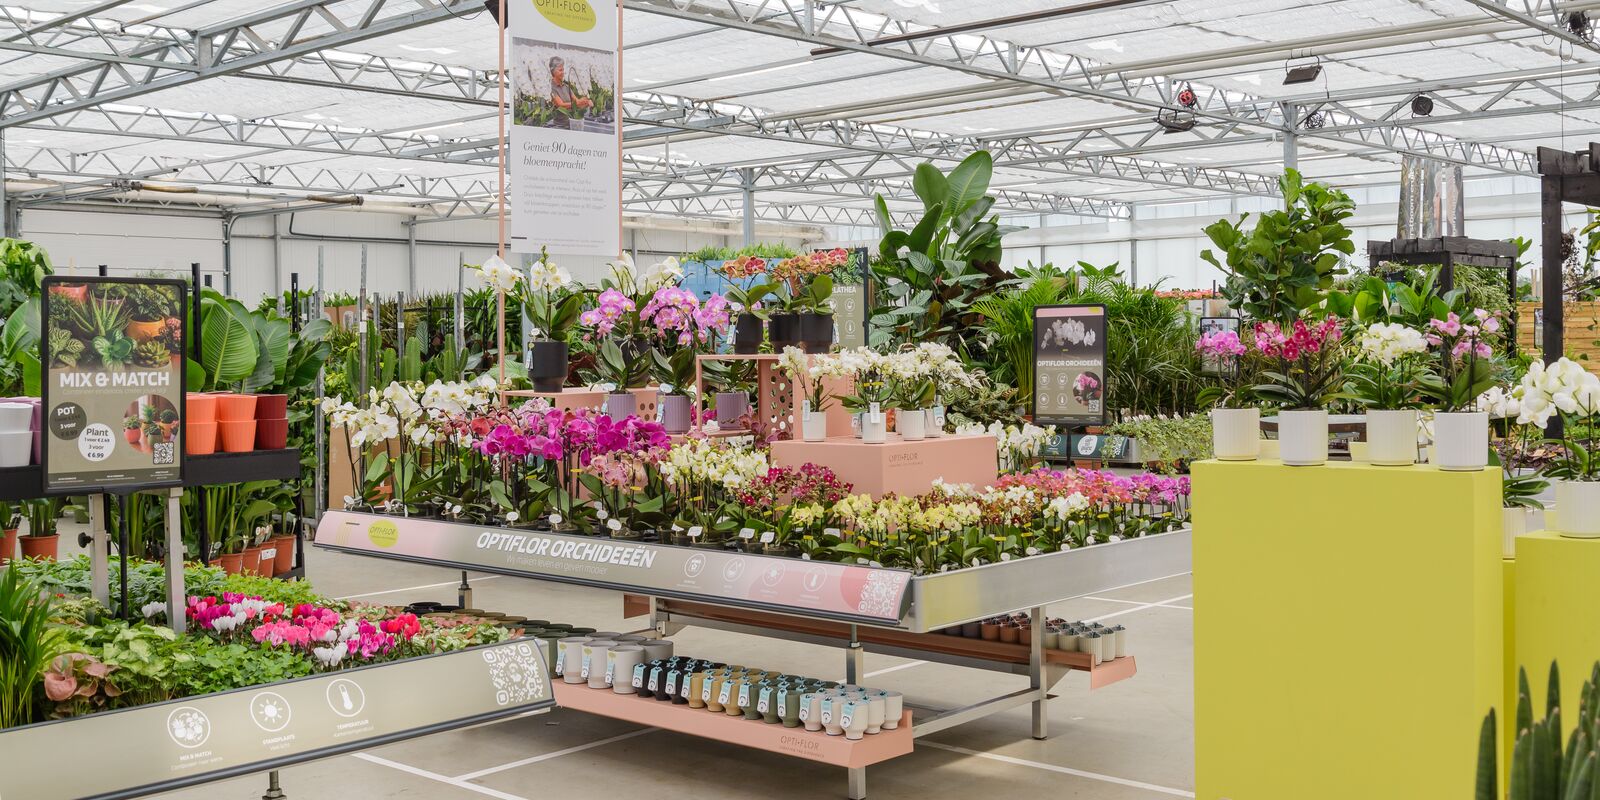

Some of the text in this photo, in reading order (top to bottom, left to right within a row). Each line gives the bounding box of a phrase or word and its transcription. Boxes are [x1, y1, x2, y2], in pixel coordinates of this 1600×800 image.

[523, 140, 608, 158] Geniet 90 dagen van
[523, 155, 587, 170] bloemenpracht!
[60, 371, 170, 388] MIX & MATCH
[57, 406, 76, 416] POT
[86, 428, 109, 437] Plant
[476, 531, 657, 569] OPTIFLOR ORCHIDEEËN
